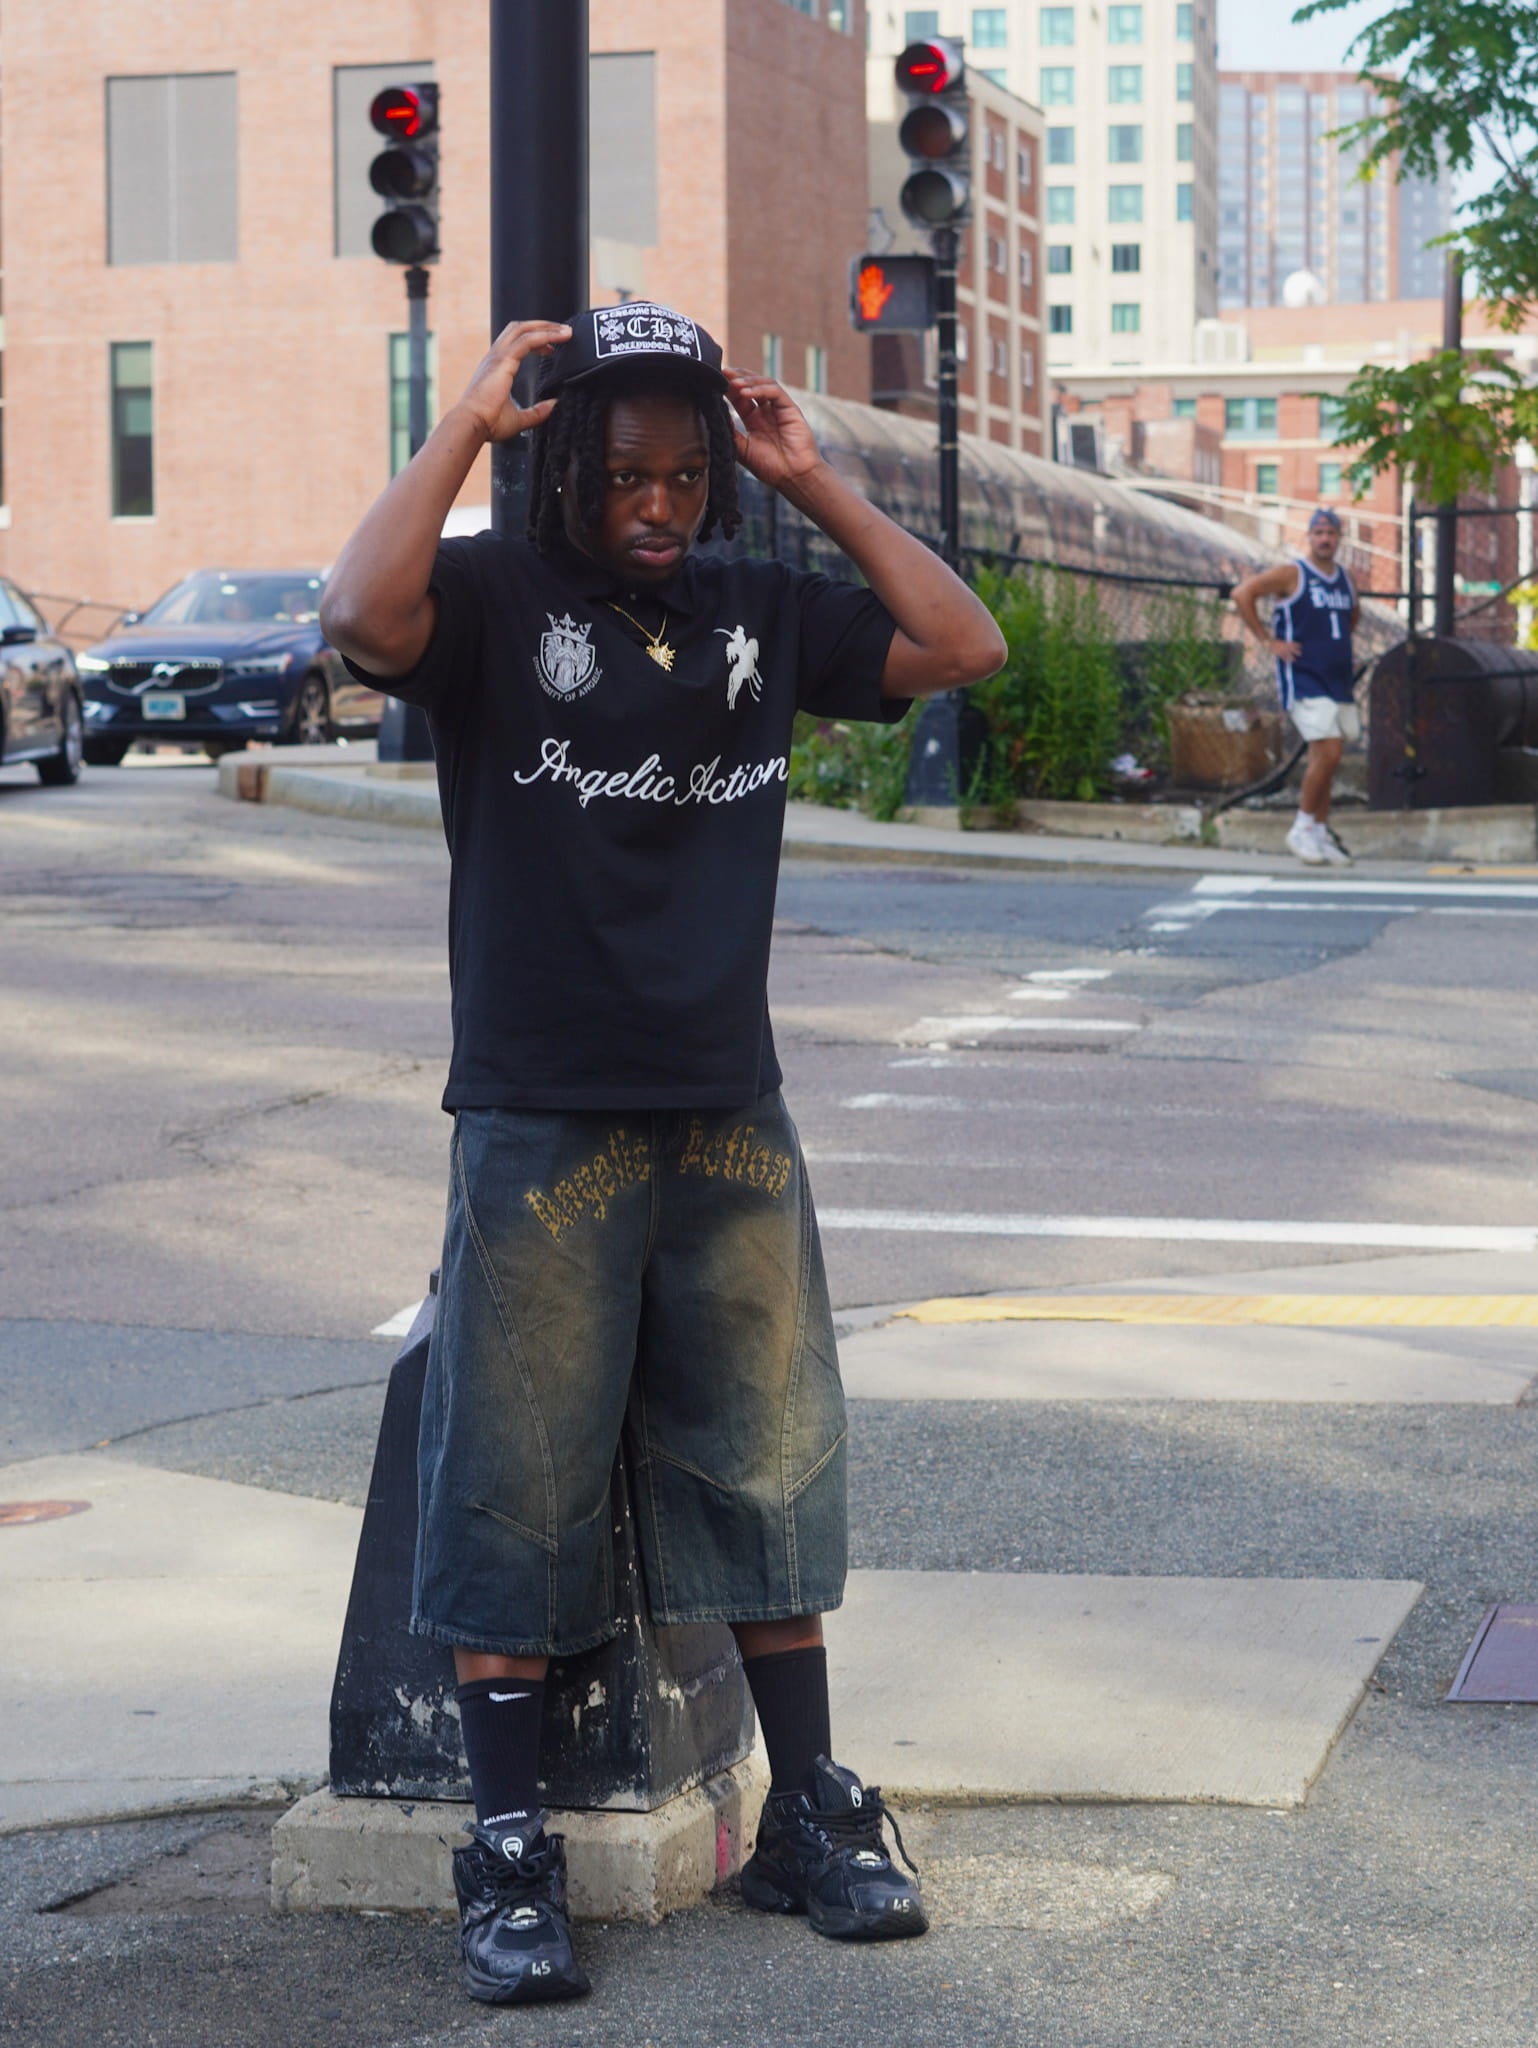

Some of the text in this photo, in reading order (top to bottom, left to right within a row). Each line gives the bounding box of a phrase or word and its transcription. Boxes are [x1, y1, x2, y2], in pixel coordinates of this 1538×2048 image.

[627, 316, 673, 342] CH
[1330, 610, 1341, 640] 1
[564, 692, 576, 702] OF
[579, 666, 603, 697] ANGELIC
[513, 737, 789, 809] Angelic Action
[483, 1810, 528, 1827] BALENCIAGA
[893, 1898, 910, 1913] 45
[532, 1960, 551, 1977] 45
